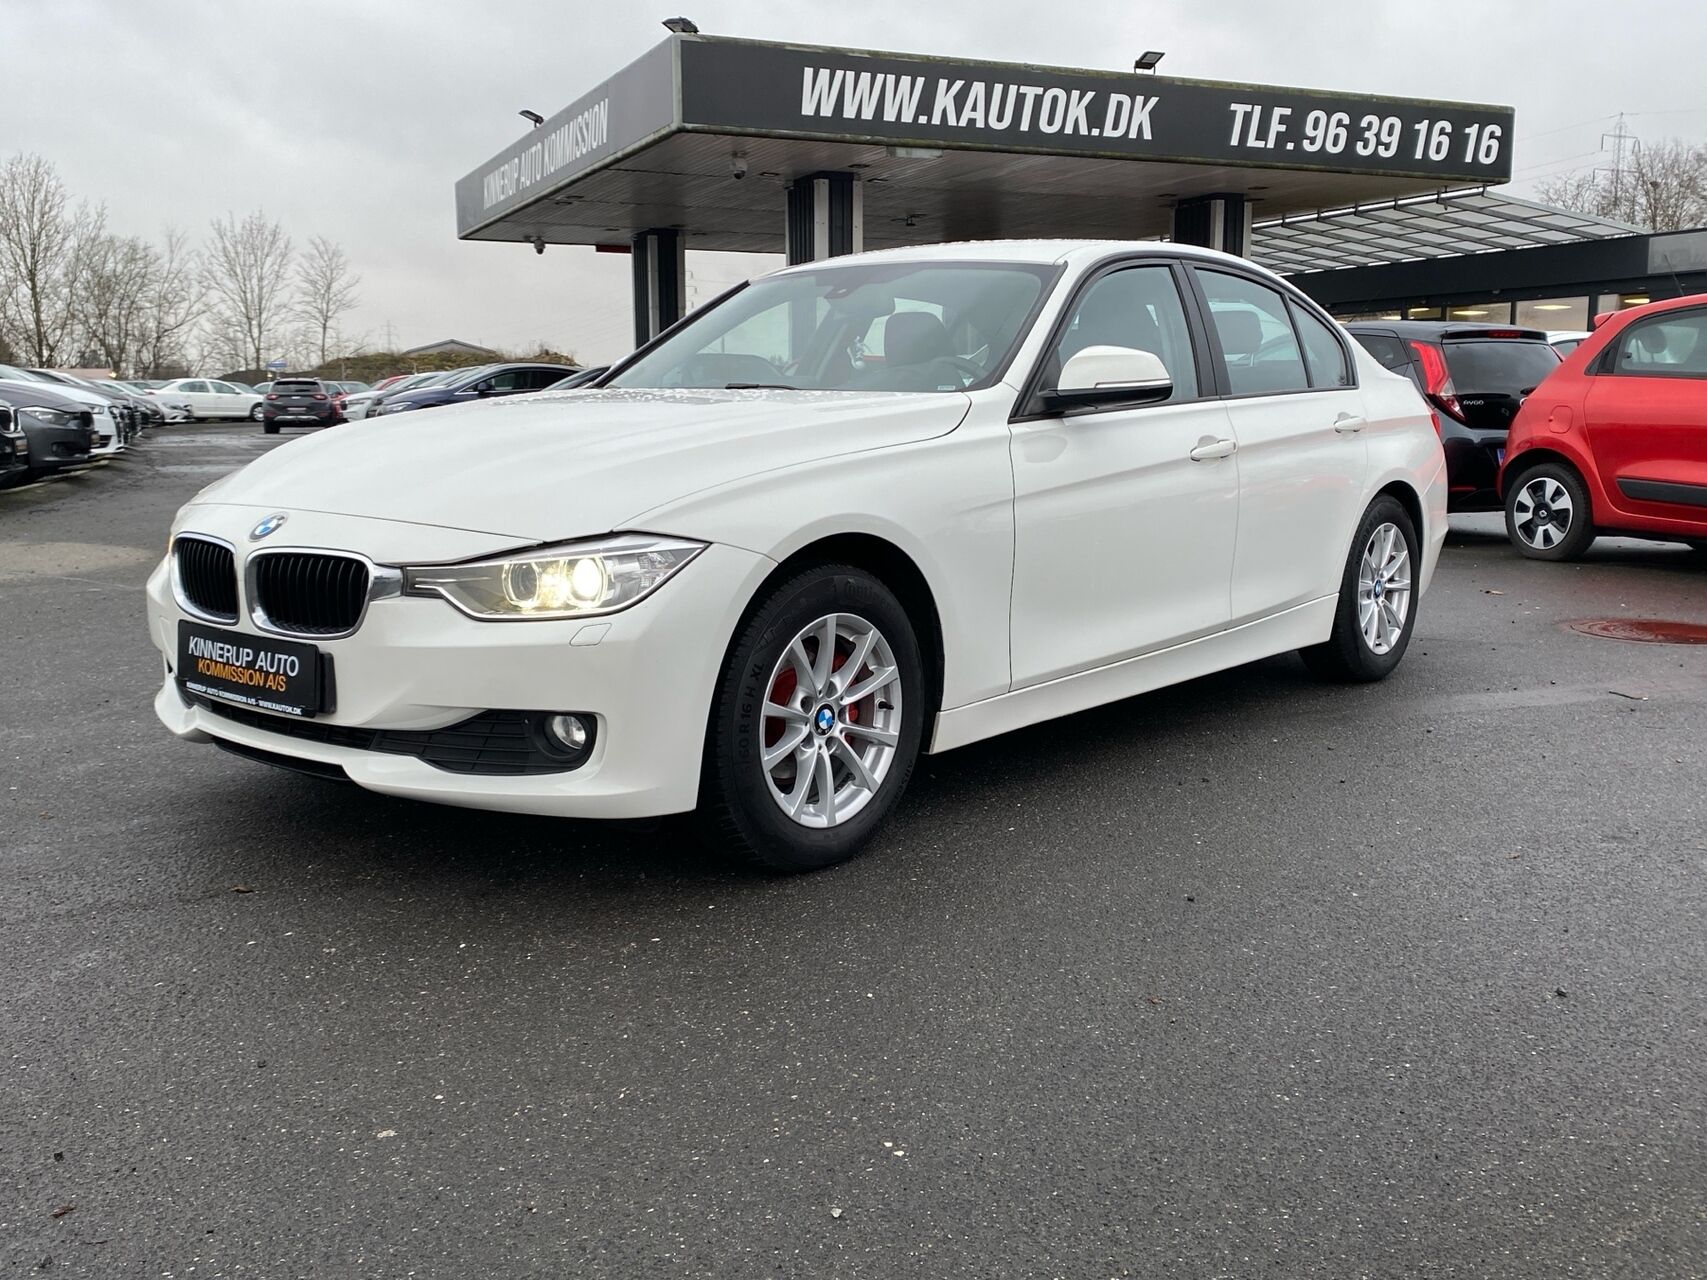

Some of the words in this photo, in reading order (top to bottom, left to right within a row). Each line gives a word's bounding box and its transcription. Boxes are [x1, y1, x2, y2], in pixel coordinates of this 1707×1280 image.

[801, 67, 1159, 140] WWW.KAUTOK.DK
[483, 157, 519, 210] KINNERUP
[519, 142, 542, 190] AUTO
[543, 98, 608, 177] KOMMISSION
[1229, 103, 1294, 150] TLF.
[1302, 110, 1350, 154] 96
[1356, 114, 1402, 158] 39
[1414, 119, 1452, 161] 16
[1464, 123, 1502, 165] 16
[188, 636, 253, 667] KINNERUP
[255, 651, 299, 677] AUTO
[198, 659, 264, 686] KOMMISSION
[266, 673, 287, 692] A/S
[741, 703, 752, 719] 16
[745, 686, 755, 698] H
